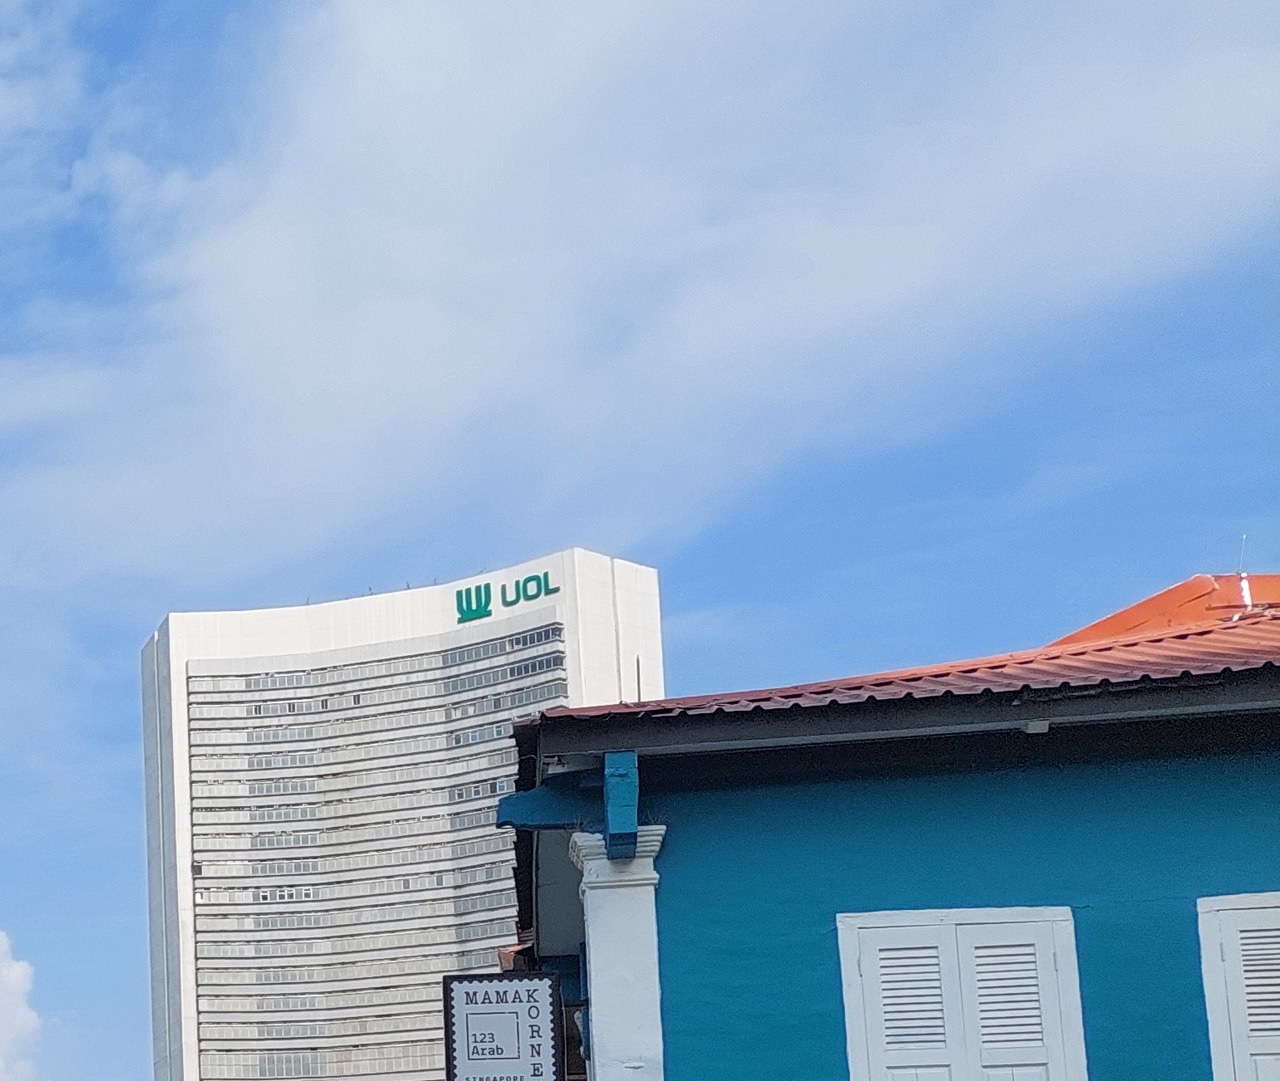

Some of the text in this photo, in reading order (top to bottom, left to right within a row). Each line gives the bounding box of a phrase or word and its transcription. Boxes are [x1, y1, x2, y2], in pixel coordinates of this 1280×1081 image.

[501, 571, 560, 607] UOL
[464, 989, 539, 1005] MAMAK
[471, 1033, 495, 1043] 123
[471, 1045, 504, 1056] Arab
